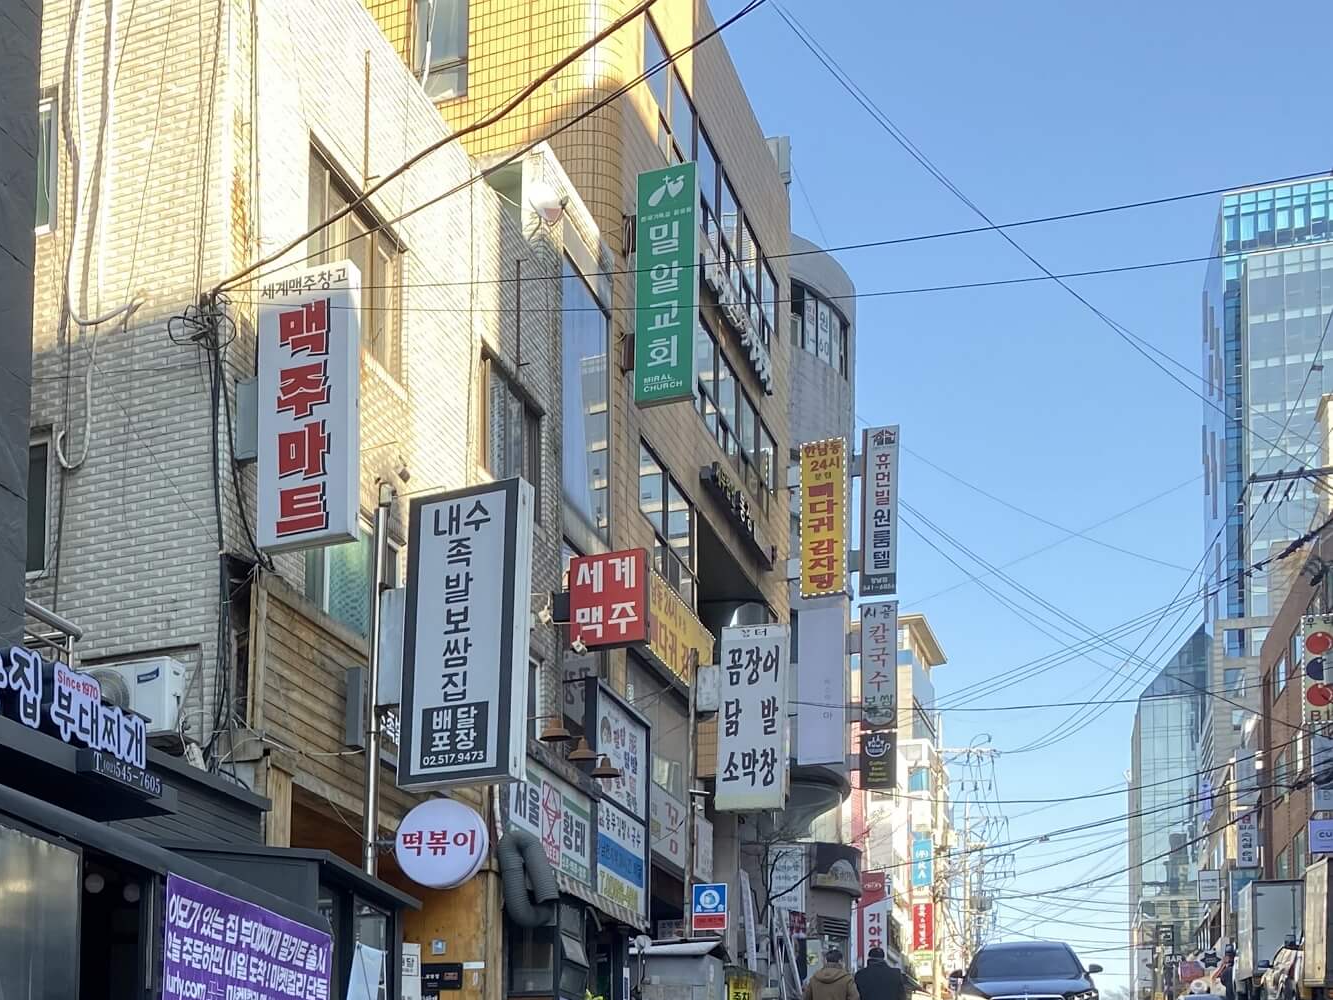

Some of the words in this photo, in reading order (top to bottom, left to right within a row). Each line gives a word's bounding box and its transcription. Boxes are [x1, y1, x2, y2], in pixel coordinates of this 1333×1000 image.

[261, 268, 348, 300] 세계맥주창고
[648, 221, 683, 367] 밀알교회
[643, 373, 674, 385] MIRAL
[643, 380, 684, 393] CHURCH
[276, 298, 331, 538] 맥주마트
[810, 456, 841, 472] 24시
[434, 499, 491, 537] 내수
[873, 453, 891, 570] 휴먼빌원룸텔
[576, 555, 637, 595] 세계
[808, 538, 839, 590] 감자탕
[441, 536, 474, 703] 족발보쌈집
[575, 600, 638, 640] 맥주
[864, 604, 894, 619] 시골
[726, 644, 780, 686] 꼼장어
[868, 623, 891, 693] 칼국수
[51, 686, 145, 769] 부대찌개
[432, 705, 478, 730] 배달
[724, 698, 743, 737] 닭
[760, 696, 779, 736] 발
[430, 728, 477, 752] 포장
[722, 747, 778, 787] 소막창
[514, 783, 540, 829] 서울
[401, 829, 477, 857] 떡볶이
[563, 810, 586, 858] 황태
[169, 893, 203, 933] 이모가
[201, 906, 225, 941] 있는
[226, 913, 239, 945] 집
[240, 917, 283, 958] 부대찌개
[279, 933, 309, 968] 밀키트
[306, 943, 328, 974] 출시
[182, 936, 226, 975] 주문하면
[225, 949, 249, 981] 내일
[249, 955, 271, 988] 도착!
[270, 963, 307, 999] 마켓컬리
